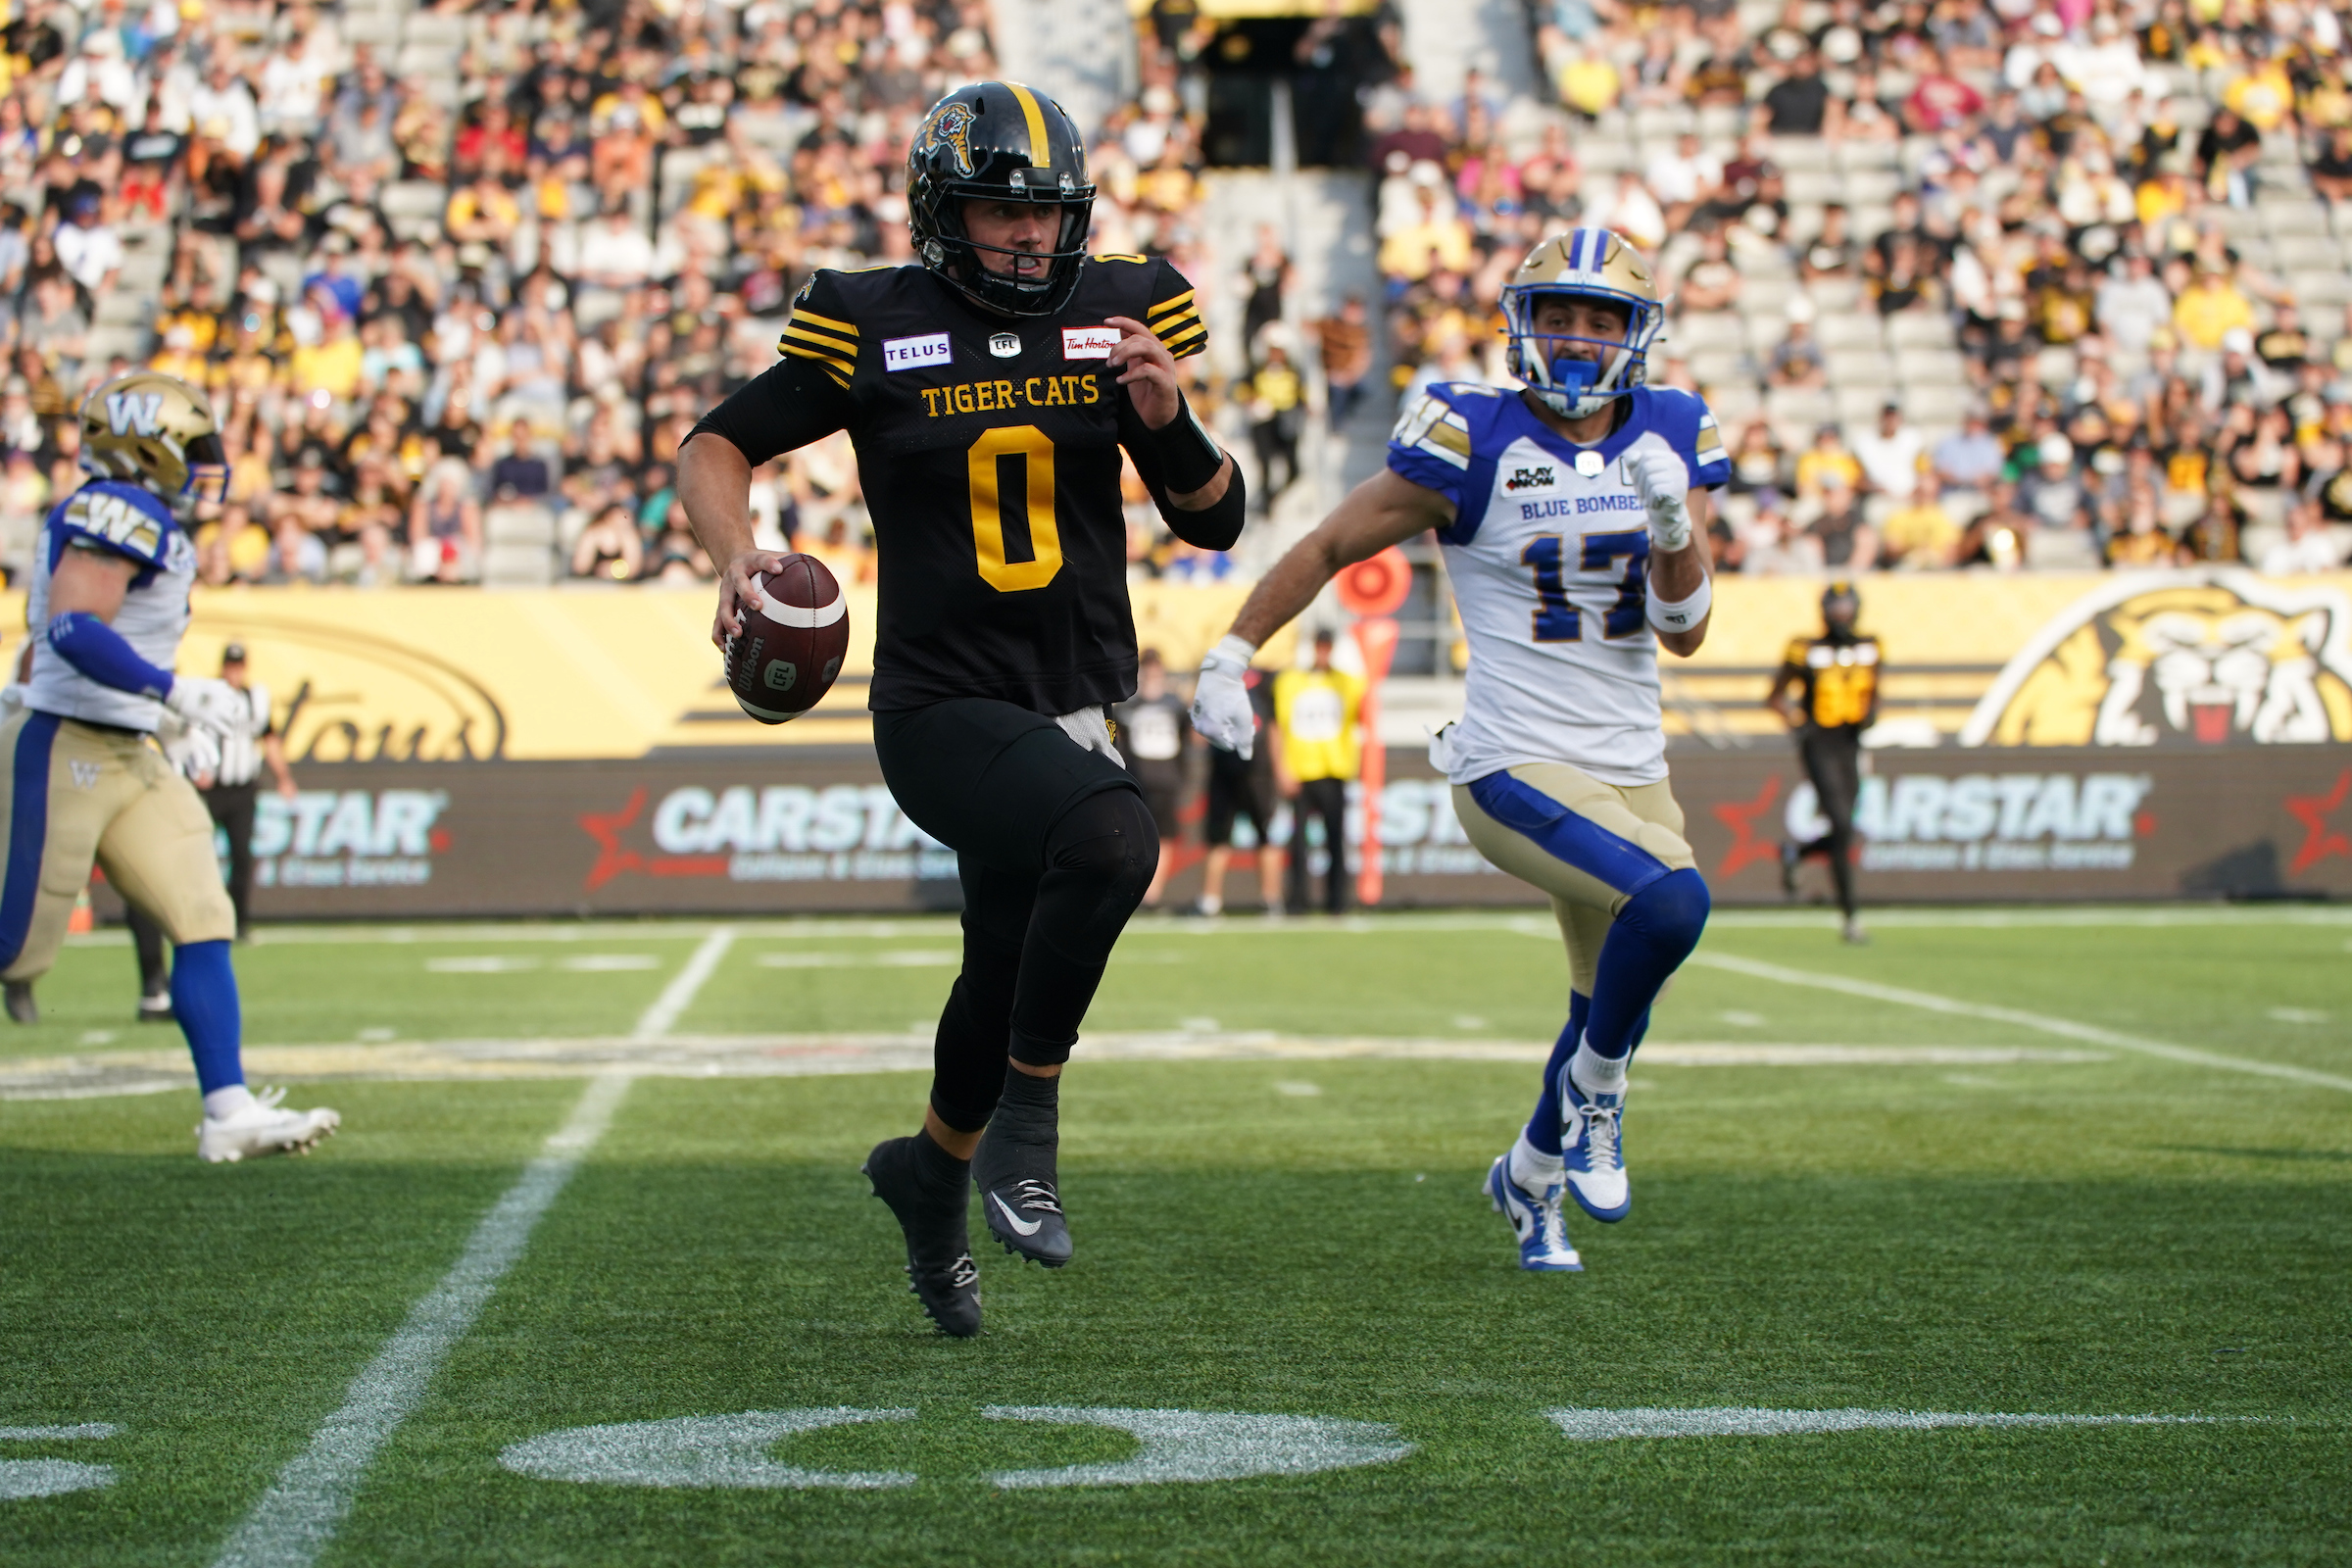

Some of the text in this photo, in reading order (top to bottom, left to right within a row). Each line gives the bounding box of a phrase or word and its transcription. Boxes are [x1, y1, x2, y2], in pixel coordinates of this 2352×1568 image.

[886, 343, 949, 362] TELUS
[995, 339, 1015, 350] CFL
[1066, 337, 1116, 351] Tim Horton
[106, 393, 163, 437] W
[920, 374, 1100, 417] TIGER-CATS
[1515, 466, 1553, 479] PLAY
[1515, 476, 1555, 488] NOW
[86, 492, 147, 546] W
[967, 424, 1064, 593] 0
[1521, 495, 1643, 520] BLUE BOMBE
[1521, 527, 1651, 643] 17
[737, 636, 765, 692] Wilson
[771, 666, 790, 687] CFL
[250, 790, 435, 858] STAR
[653, 784, 956, 854] CARST
